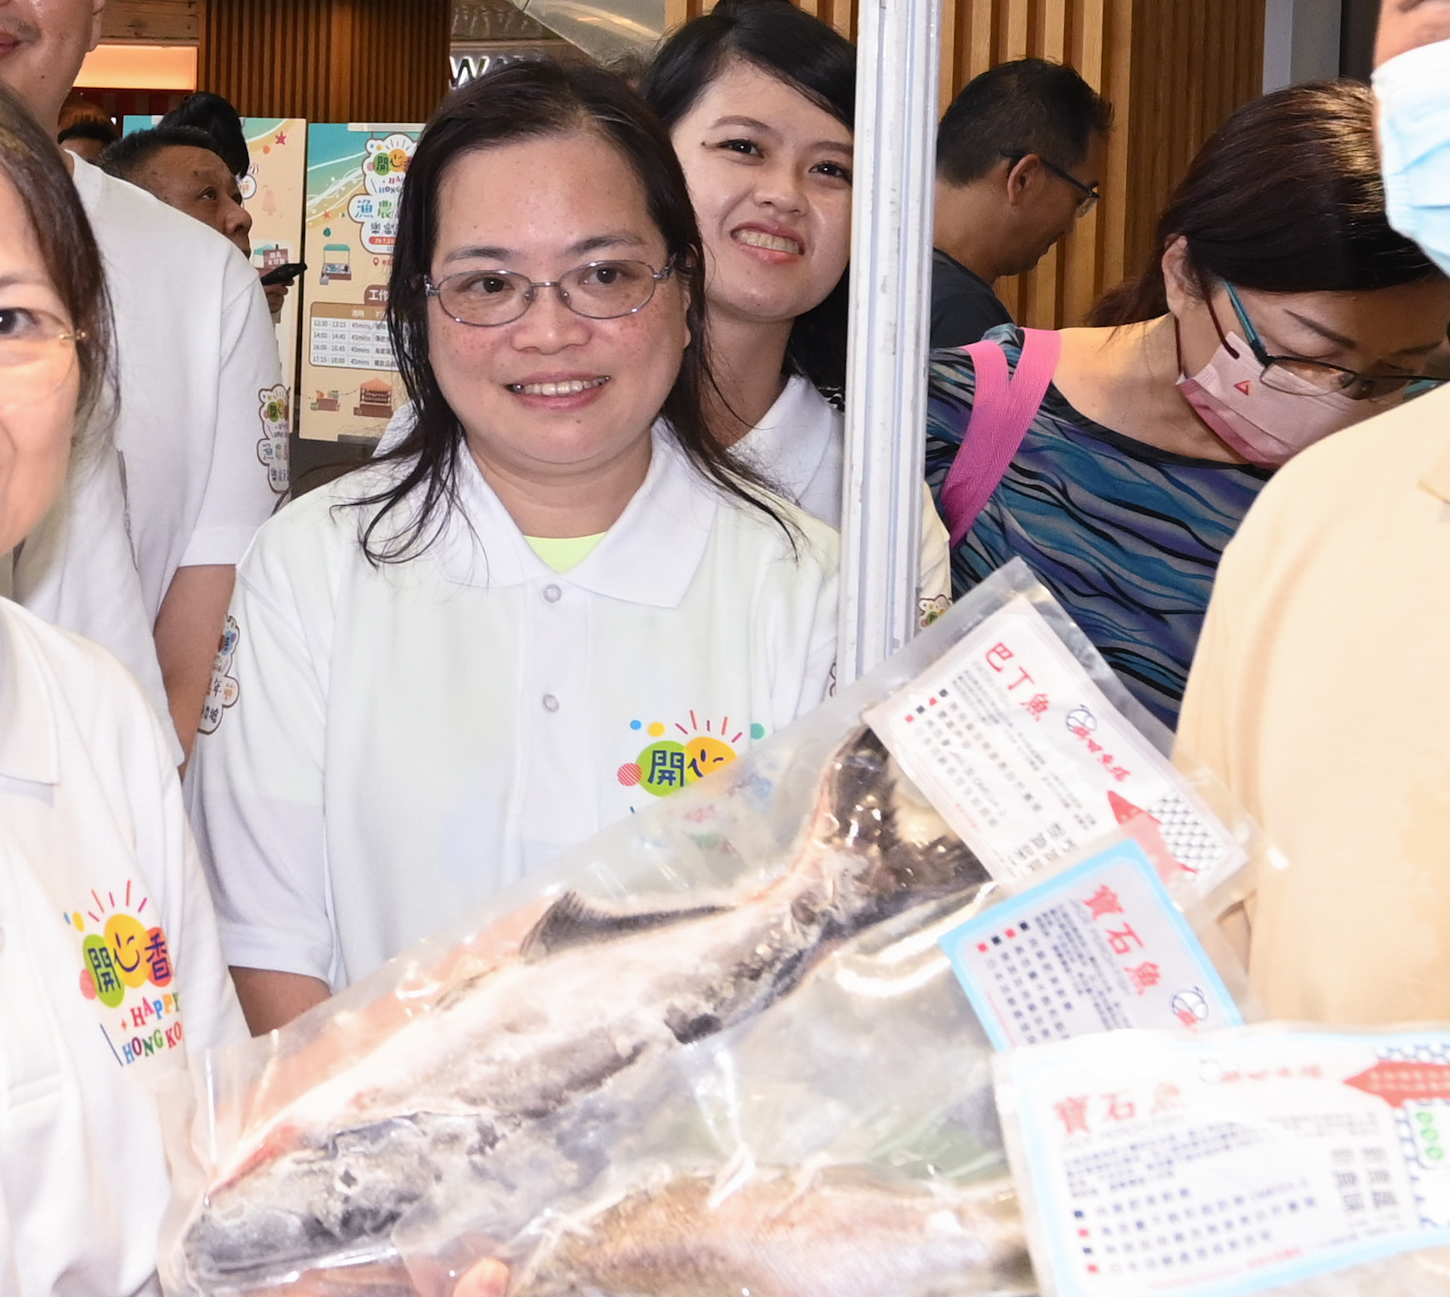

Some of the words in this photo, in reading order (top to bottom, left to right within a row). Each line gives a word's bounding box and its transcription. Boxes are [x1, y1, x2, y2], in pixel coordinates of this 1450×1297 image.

[984, 642, 1051, 723] 巴丁魚
[88, 932, 172, 994] 開心香
[1082, 883, 1163, 998] 寶石魚
[130, 992, 181, 1028] HAPPY
[122, 1029, 165, 1065] HONG
